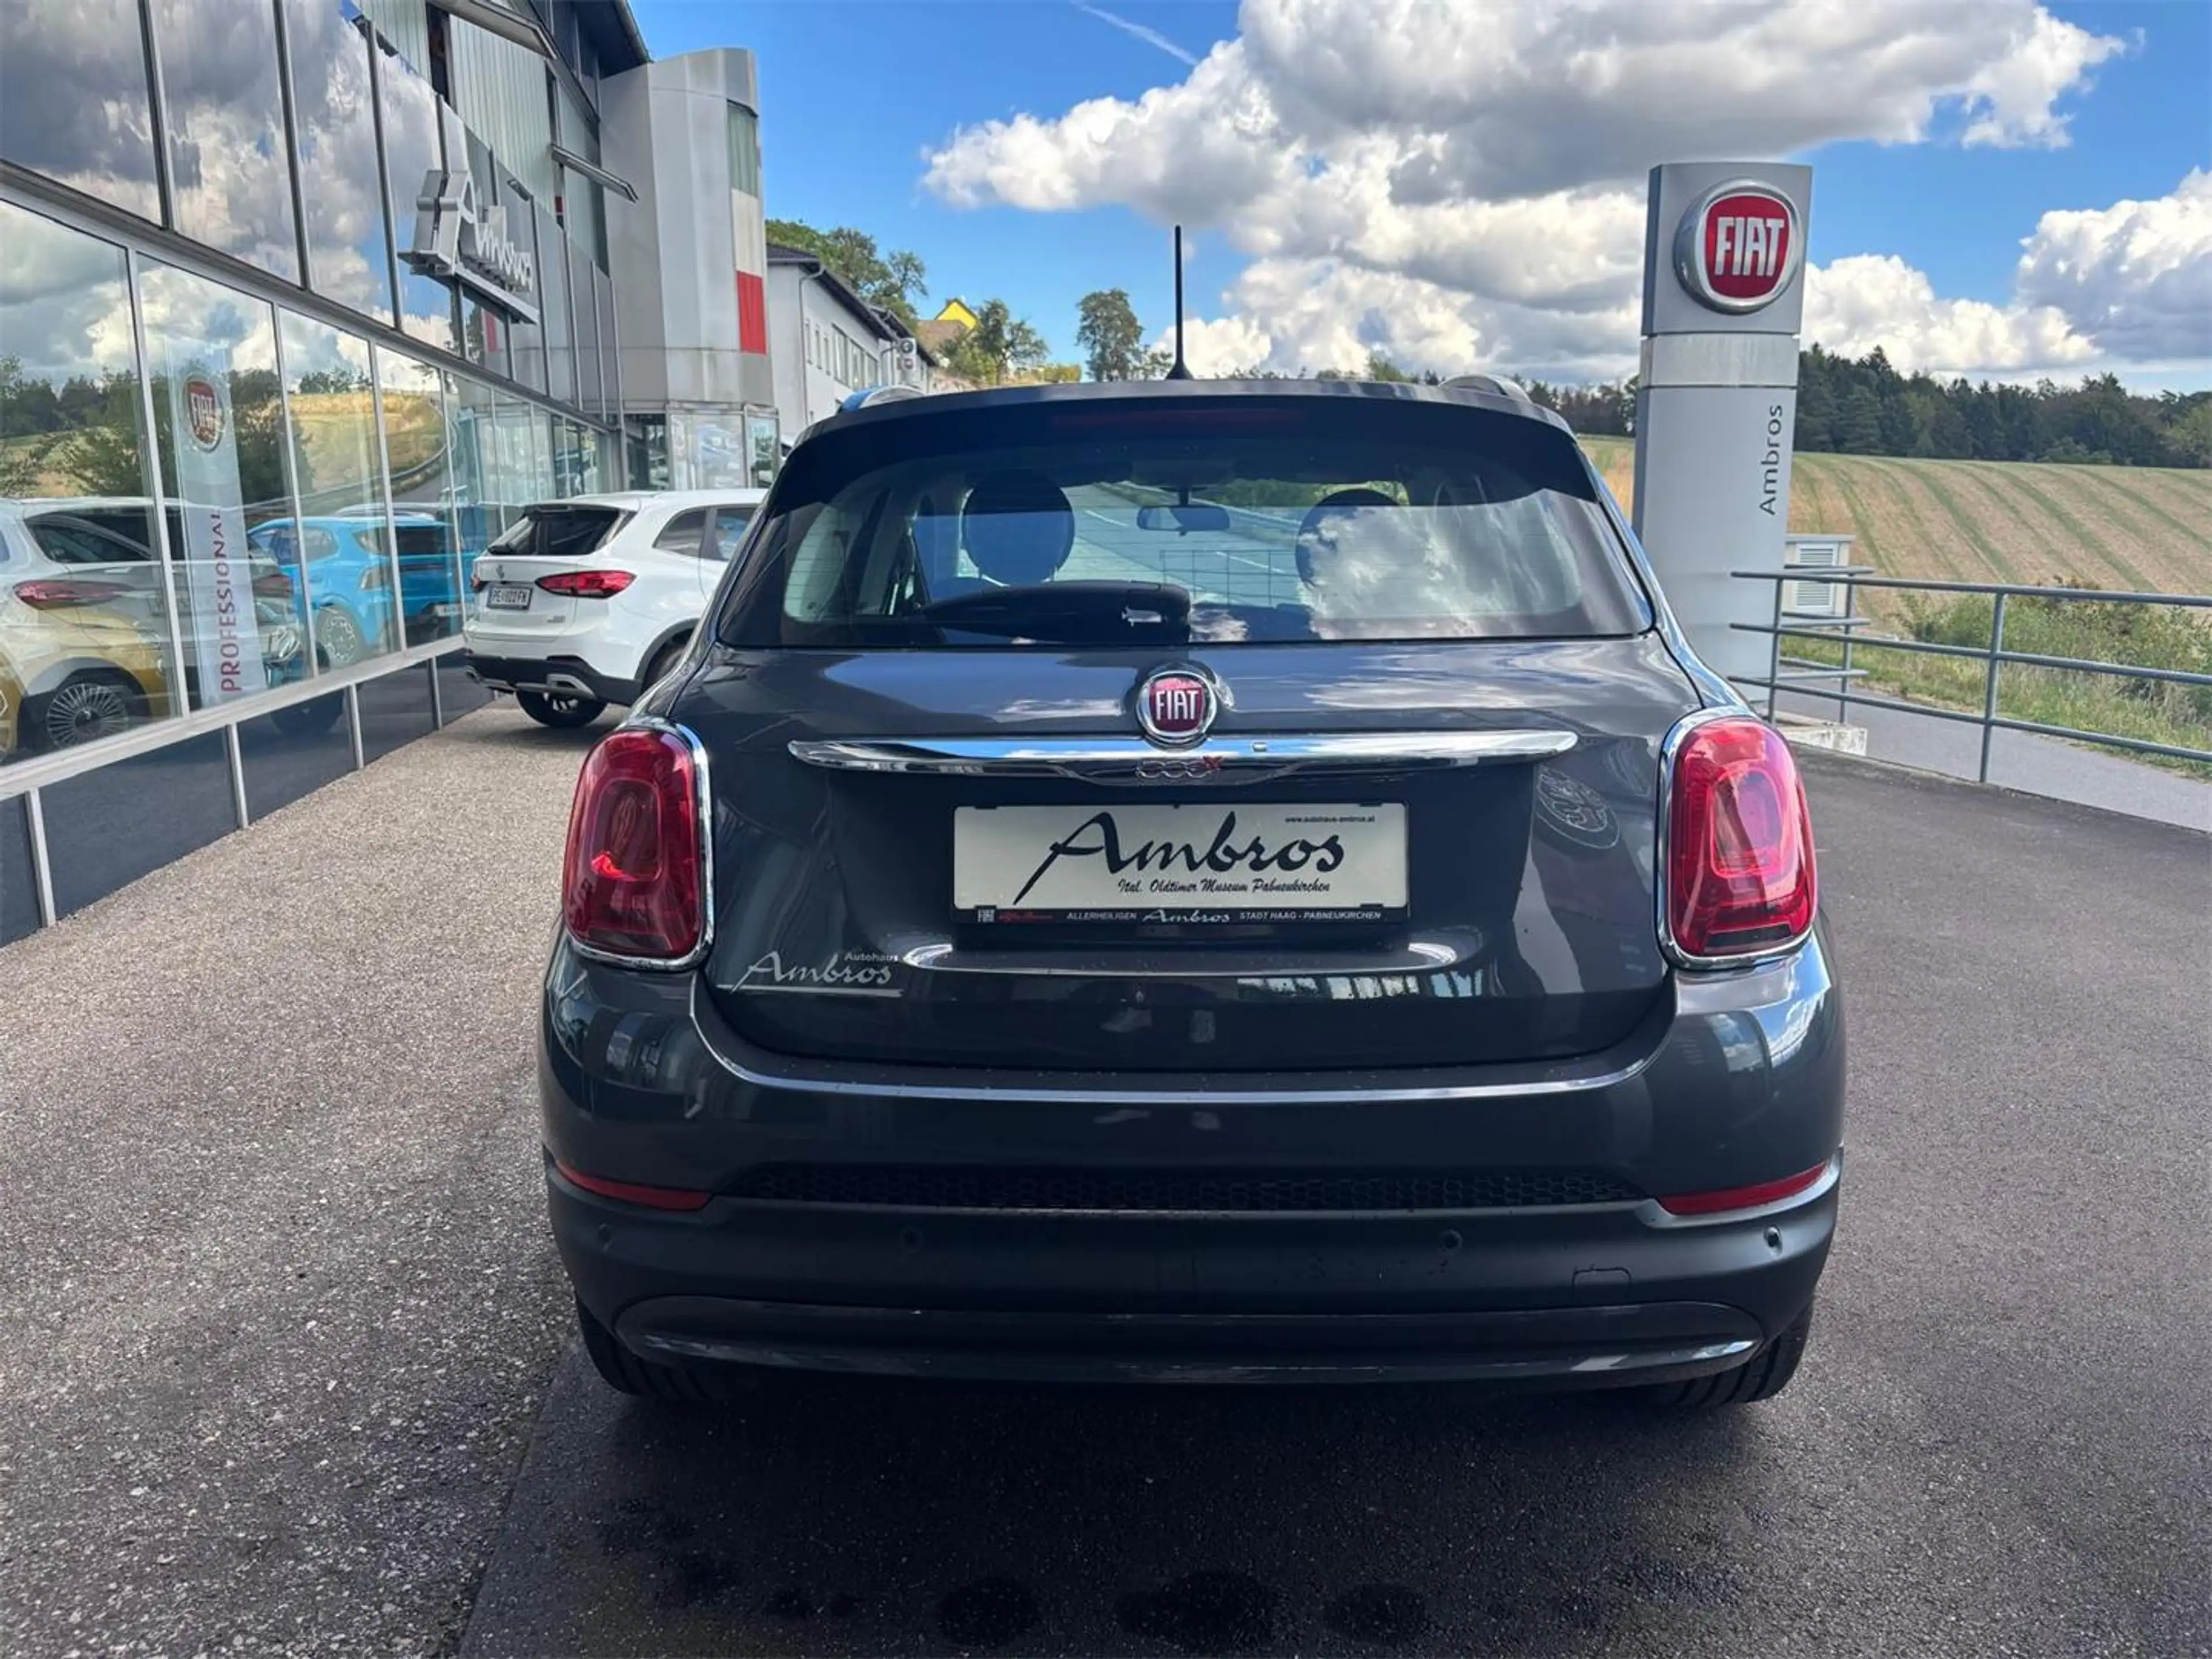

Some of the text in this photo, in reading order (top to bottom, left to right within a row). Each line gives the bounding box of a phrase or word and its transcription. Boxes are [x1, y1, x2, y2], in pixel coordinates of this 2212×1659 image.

[1714, 216, 1785, 277] FIAT
[190, 392, 215, 430] FIAT
[1759, 404, 1783, 516] Ambros
[1155, 690, 1199, 721] FIAT
[1012, 810, 1345, 906] Ambros
[1149, 878, 1198, 893] Oldtimer
[1200, 878, 1248, 893] Museum
[1141, 909, 1230, 923] Ambros
[1239, 911, 1268, 920] STADT
[1270, 911, 1297, 920] HAAG
[730, 950, 892, 994] Ambros
